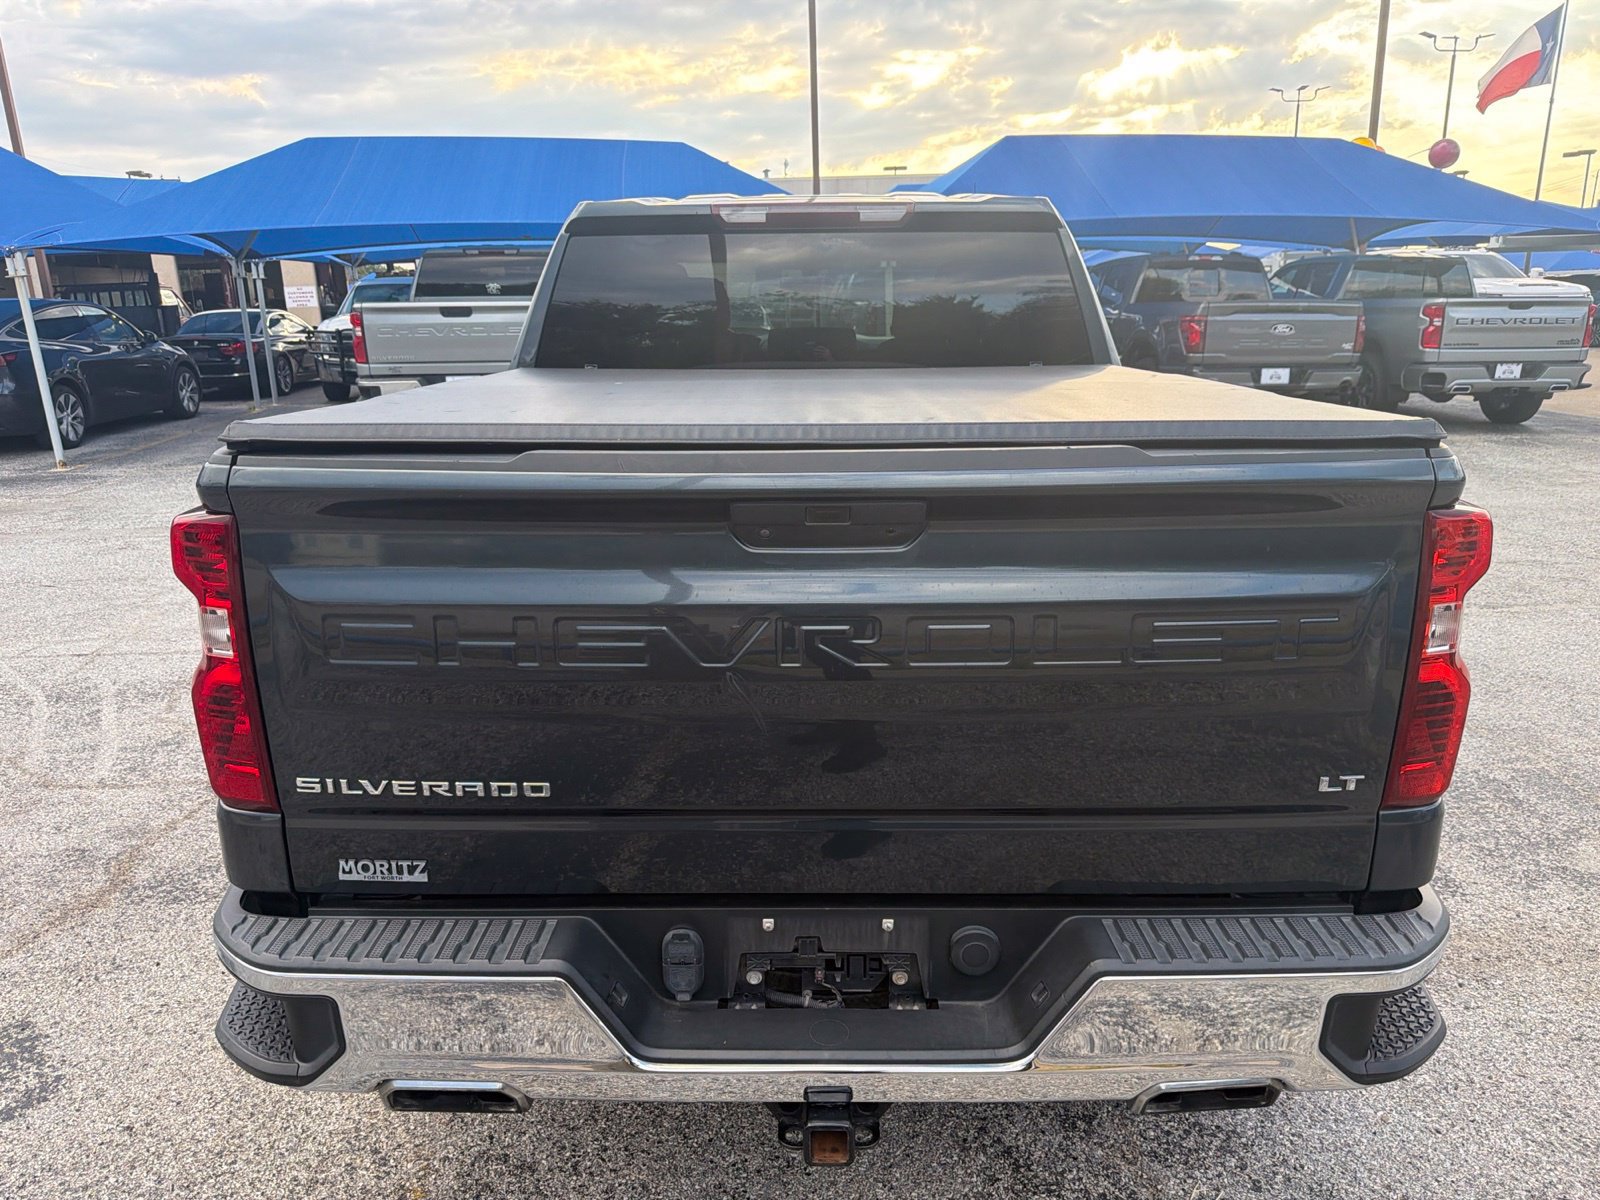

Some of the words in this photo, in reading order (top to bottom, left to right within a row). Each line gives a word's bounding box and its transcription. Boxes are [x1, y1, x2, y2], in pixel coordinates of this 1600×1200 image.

[1455, 317, 1580, 326] CHEVROLET
[377, 327, 523, 338] CHEVROLE
[321, 609, 1340, 667] CHEVROLET
[295, 777, 551, 798] SILVERADO
[1318, 775, 1365, 792] LT
[338, 858, 428, 877] MORITZ
